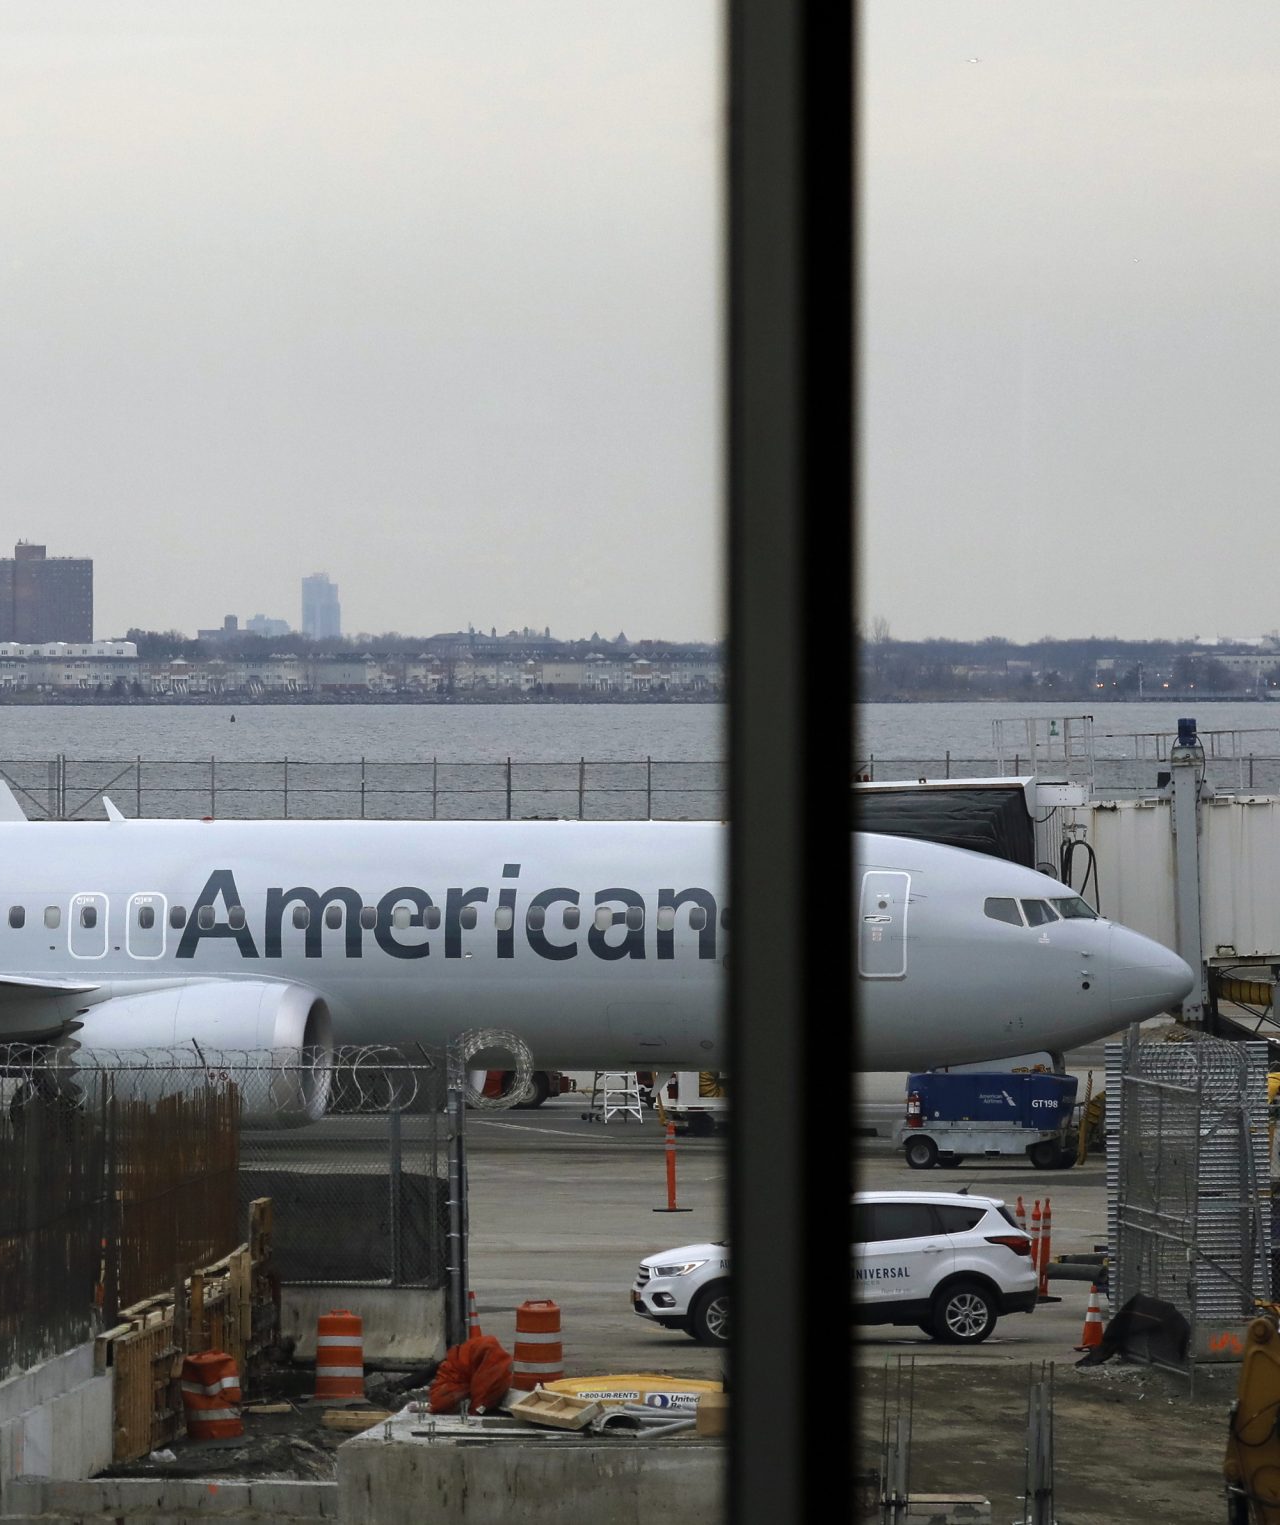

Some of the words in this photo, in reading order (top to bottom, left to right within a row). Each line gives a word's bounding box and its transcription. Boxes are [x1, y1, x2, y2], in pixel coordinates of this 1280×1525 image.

[176, 864, 717, 960] American
[1031, 1099, 1059, 1108] GT198
[670, 1394, 701, 1403] United
